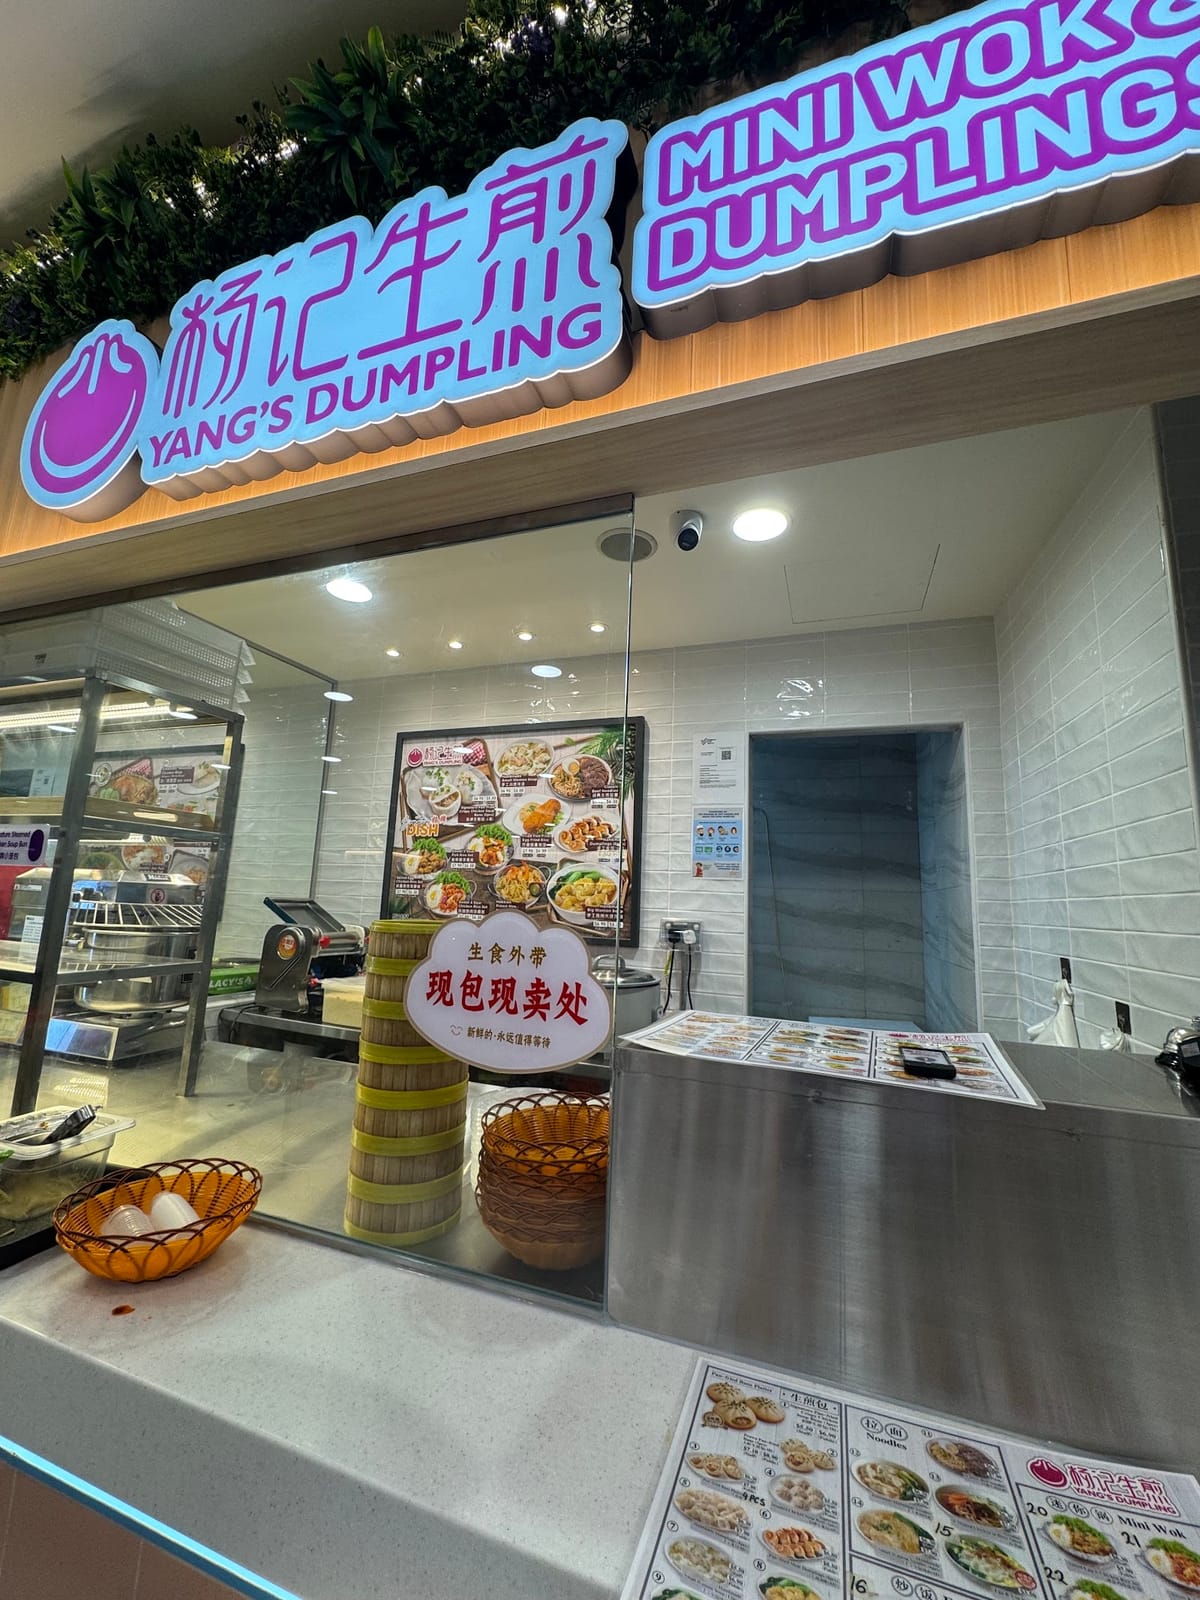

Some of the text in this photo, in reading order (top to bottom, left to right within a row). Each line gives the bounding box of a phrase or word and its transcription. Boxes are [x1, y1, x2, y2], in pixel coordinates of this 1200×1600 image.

[664, 0, 1122, 202] MINI WOK
[655, 50, 1200, 284] DUMPLING
[162, 135, 609, 418] 杨记生煎
[148, 303, 602, 468] YANG'S DUMPLING
[406, 823, 440, 836] DISH
[468, 942, 547, 968] 生食外带
[426, 970, 588, 1025] 现包现卖处
[866, 1432, 907, 1451] Noodles
[1068, 1466, 1170, 1506] 杨记生煎
[1026, 1502, 1048, 1517] 20
[1076, 1487, 1177, 1515] YANG'S DUMPLING
[935, 1522, 954, 1537] 15
[1118, 1514, 1187, 1540] Mini Wok
[1121, 1531, 1142, 1549] 21
[850, 1575, 867, 1594] 16
[1044, 1566, 1069, 1586] 22
